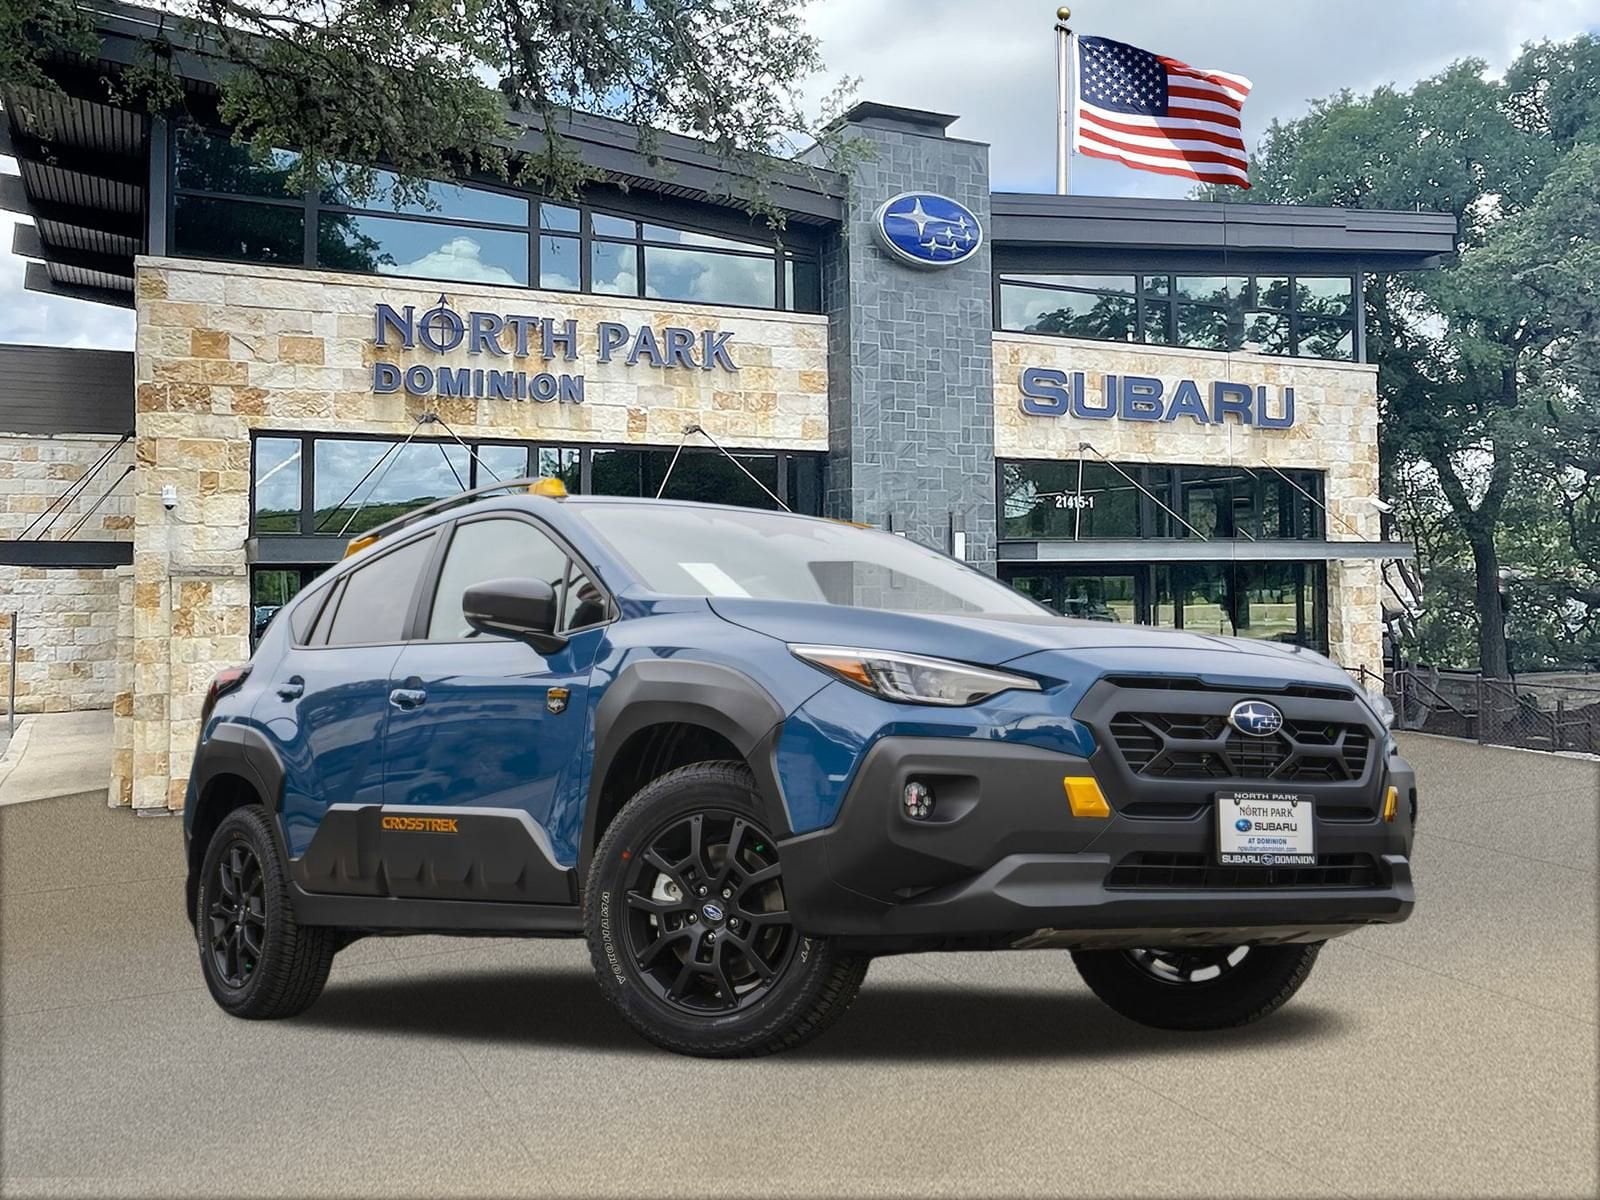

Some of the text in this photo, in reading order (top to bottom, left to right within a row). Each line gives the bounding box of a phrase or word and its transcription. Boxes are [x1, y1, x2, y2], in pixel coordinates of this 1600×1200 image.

[374, 299, 741, 373] NORTH PARK
[373, 362, 585, 404] DOMINION
[1019, 367, 1295, 430] SUBARU
[1234, 792, 1298, 801] NORTH PARK
[1239, 805, 1294, 818] NORTH PARK
[382, 816, 459, 833] CROSSTREK
[1254, 822, 1297, 832] SUBARU
[1247, 837, 1287, 845] AT DOMINION
[1221, 854, 1315, 865] SUBARU DOMINION
[601, 891, 626, 985] YOKOHAMA
